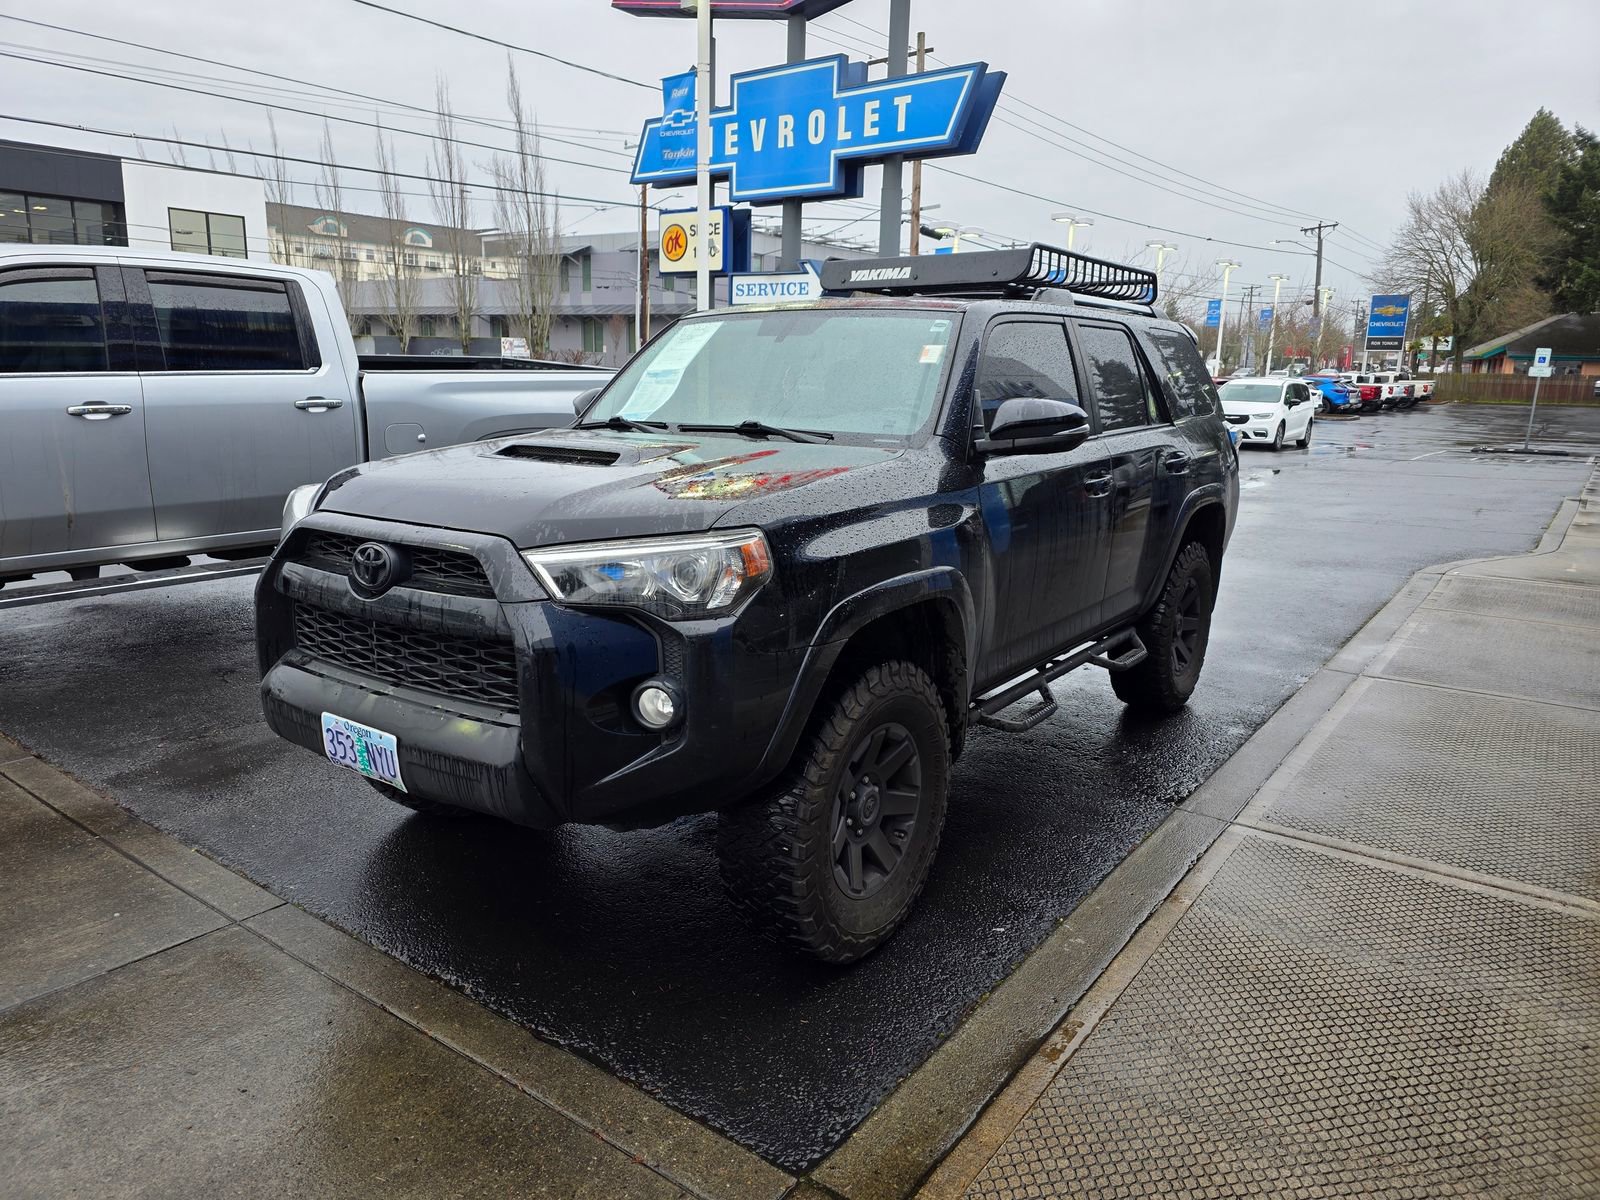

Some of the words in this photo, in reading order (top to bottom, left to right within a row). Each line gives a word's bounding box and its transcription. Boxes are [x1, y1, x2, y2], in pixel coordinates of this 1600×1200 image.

[660, 128, 695, 138] CHEVROLET
[709, 94, 912, 158] EVROLET
[662, 147, 695, 160] Tonkin
[666, 230, 683, 255] OK
[849, 266, 912, 282] YAKIMA
[735, 282, 809, 297] SERVICE
[343, 721, 372, 739] Oregon
[326, 727, 358, 764] 353
[364, 740, 397, 779] NYU
